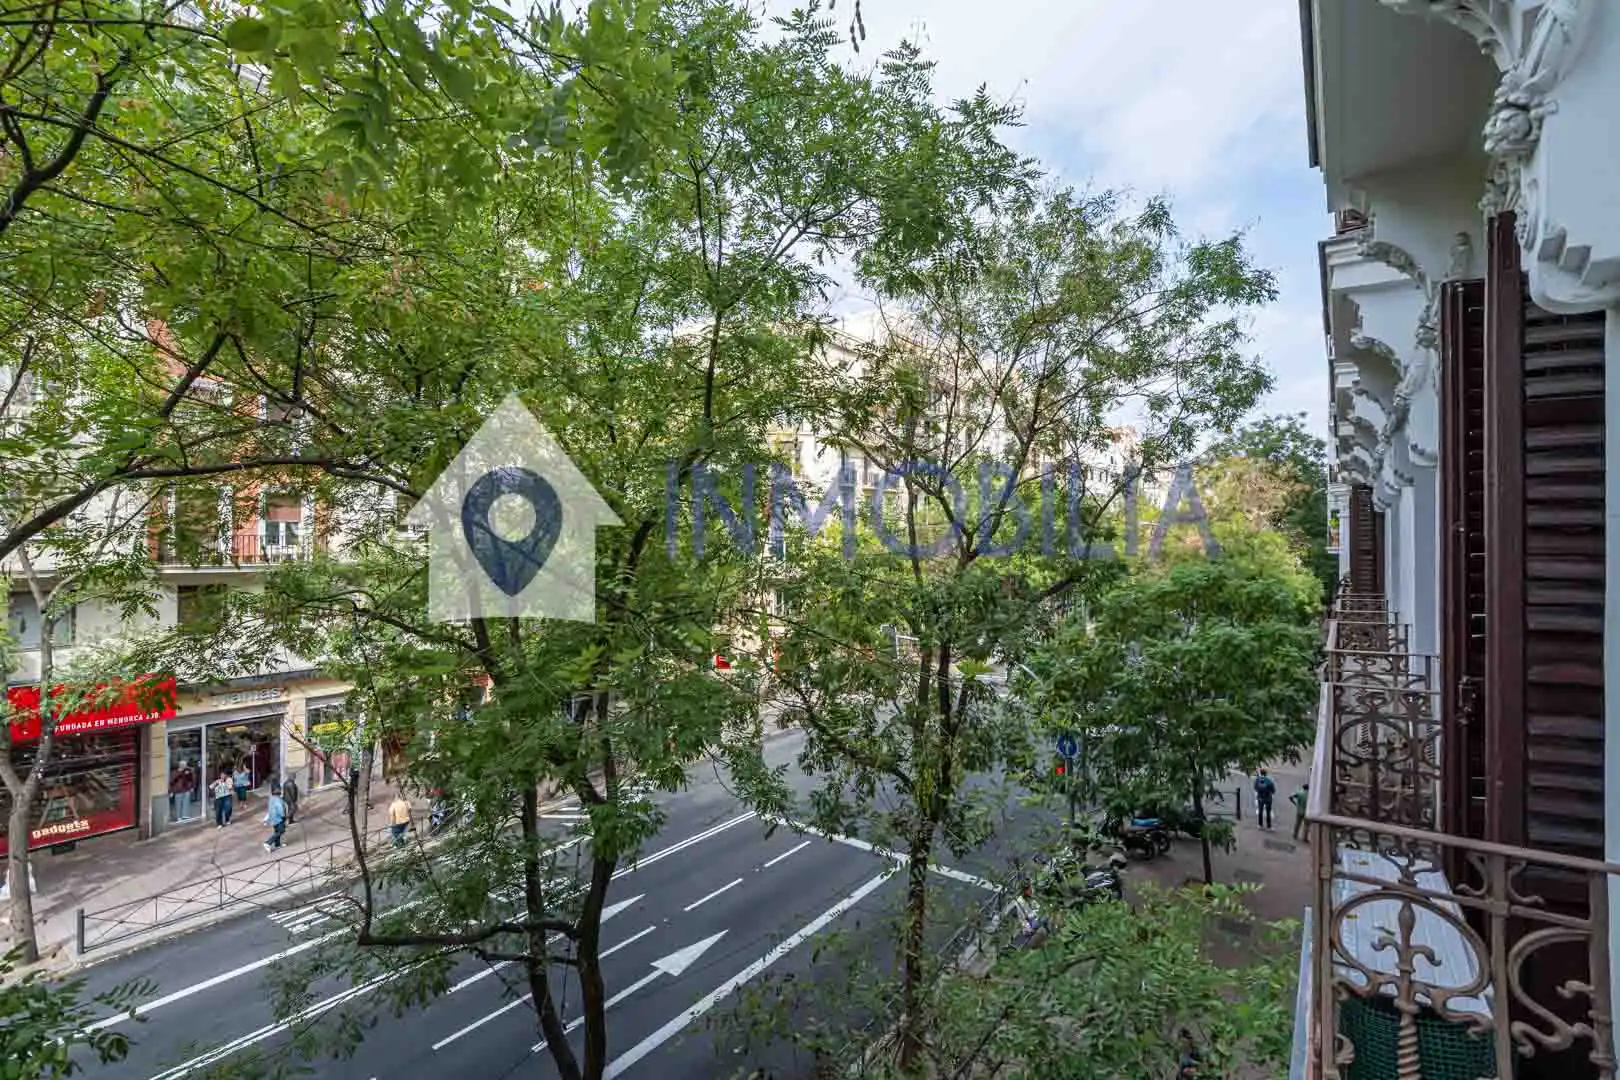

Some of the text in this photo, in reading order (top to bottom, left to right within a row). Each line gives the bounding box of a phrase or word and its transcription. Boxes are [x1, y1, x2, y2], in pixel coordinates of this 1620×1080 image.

[54, 721, 92, 733] FUNDADA
[94, 719, 105, 727] EN
[107, 714, 143, 726] MENORCA
